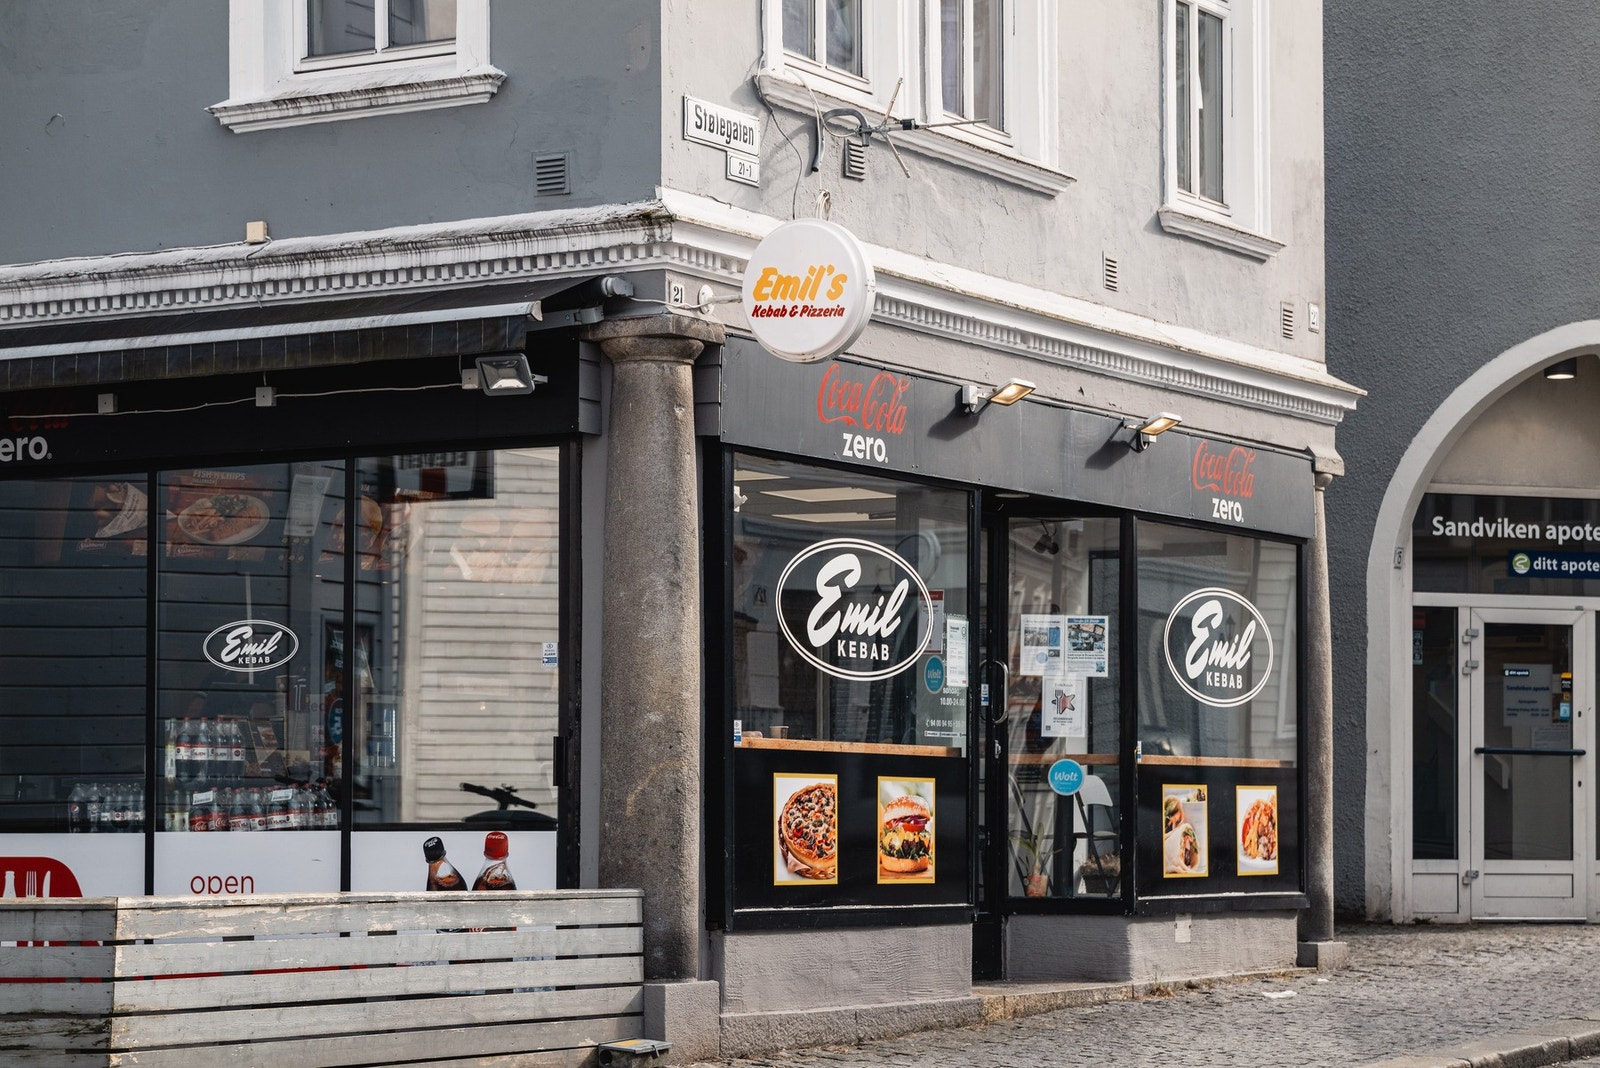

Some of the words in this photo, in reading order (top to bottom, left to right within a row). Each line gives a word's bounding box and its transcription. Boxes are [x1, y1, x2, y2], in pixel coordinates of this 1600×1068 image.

[695, 104, 754, 146] Stølegaten
[753, 264, 848, 302] Emil's
[673, 285, 683, 304] 21
[752, 304, 788, 318] Kebab
[789, 304, 799, 318] &
[800, 304, 845, 318] Pizzeria
[1432, 516, 1540, 540] Sandviken
[1533, 557, 1558, 571] ditt
[807, 553, 909, 648] Emil
[221, 626, 283, 663] Emil
[1185, 600, 1256, 680] Emil
[238, 656, 271, 664] KEBAB
[837, 640, 889, 661] KEBAB
[1206, 671, 1243, 690] KEBAB
[1054, 771, 1079, 782] Wolt
[190, 875, 255, 895] open
